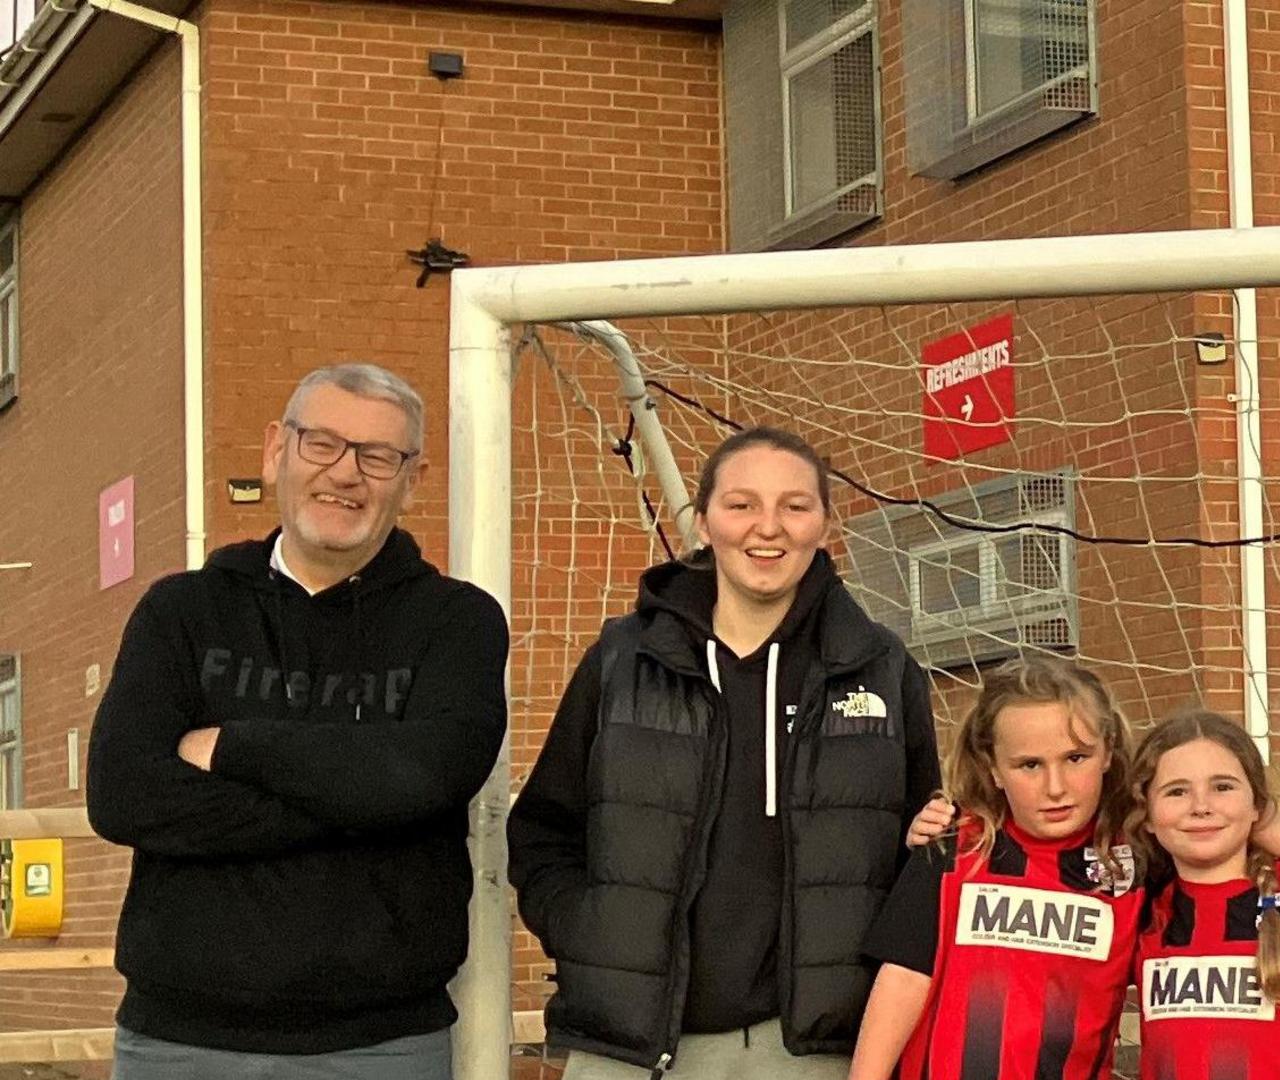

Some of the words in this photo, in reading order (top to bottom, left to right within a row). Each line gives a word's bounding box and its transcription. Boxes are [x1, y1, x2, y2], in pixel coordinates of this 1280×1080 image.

[926, 339, 1009, 393] REFRESHMENTS
[200, 647, 413, 714] Firerap
[971, 894, 1101, 945] MANE
[1150, 966, 1262, 1007] MANE
